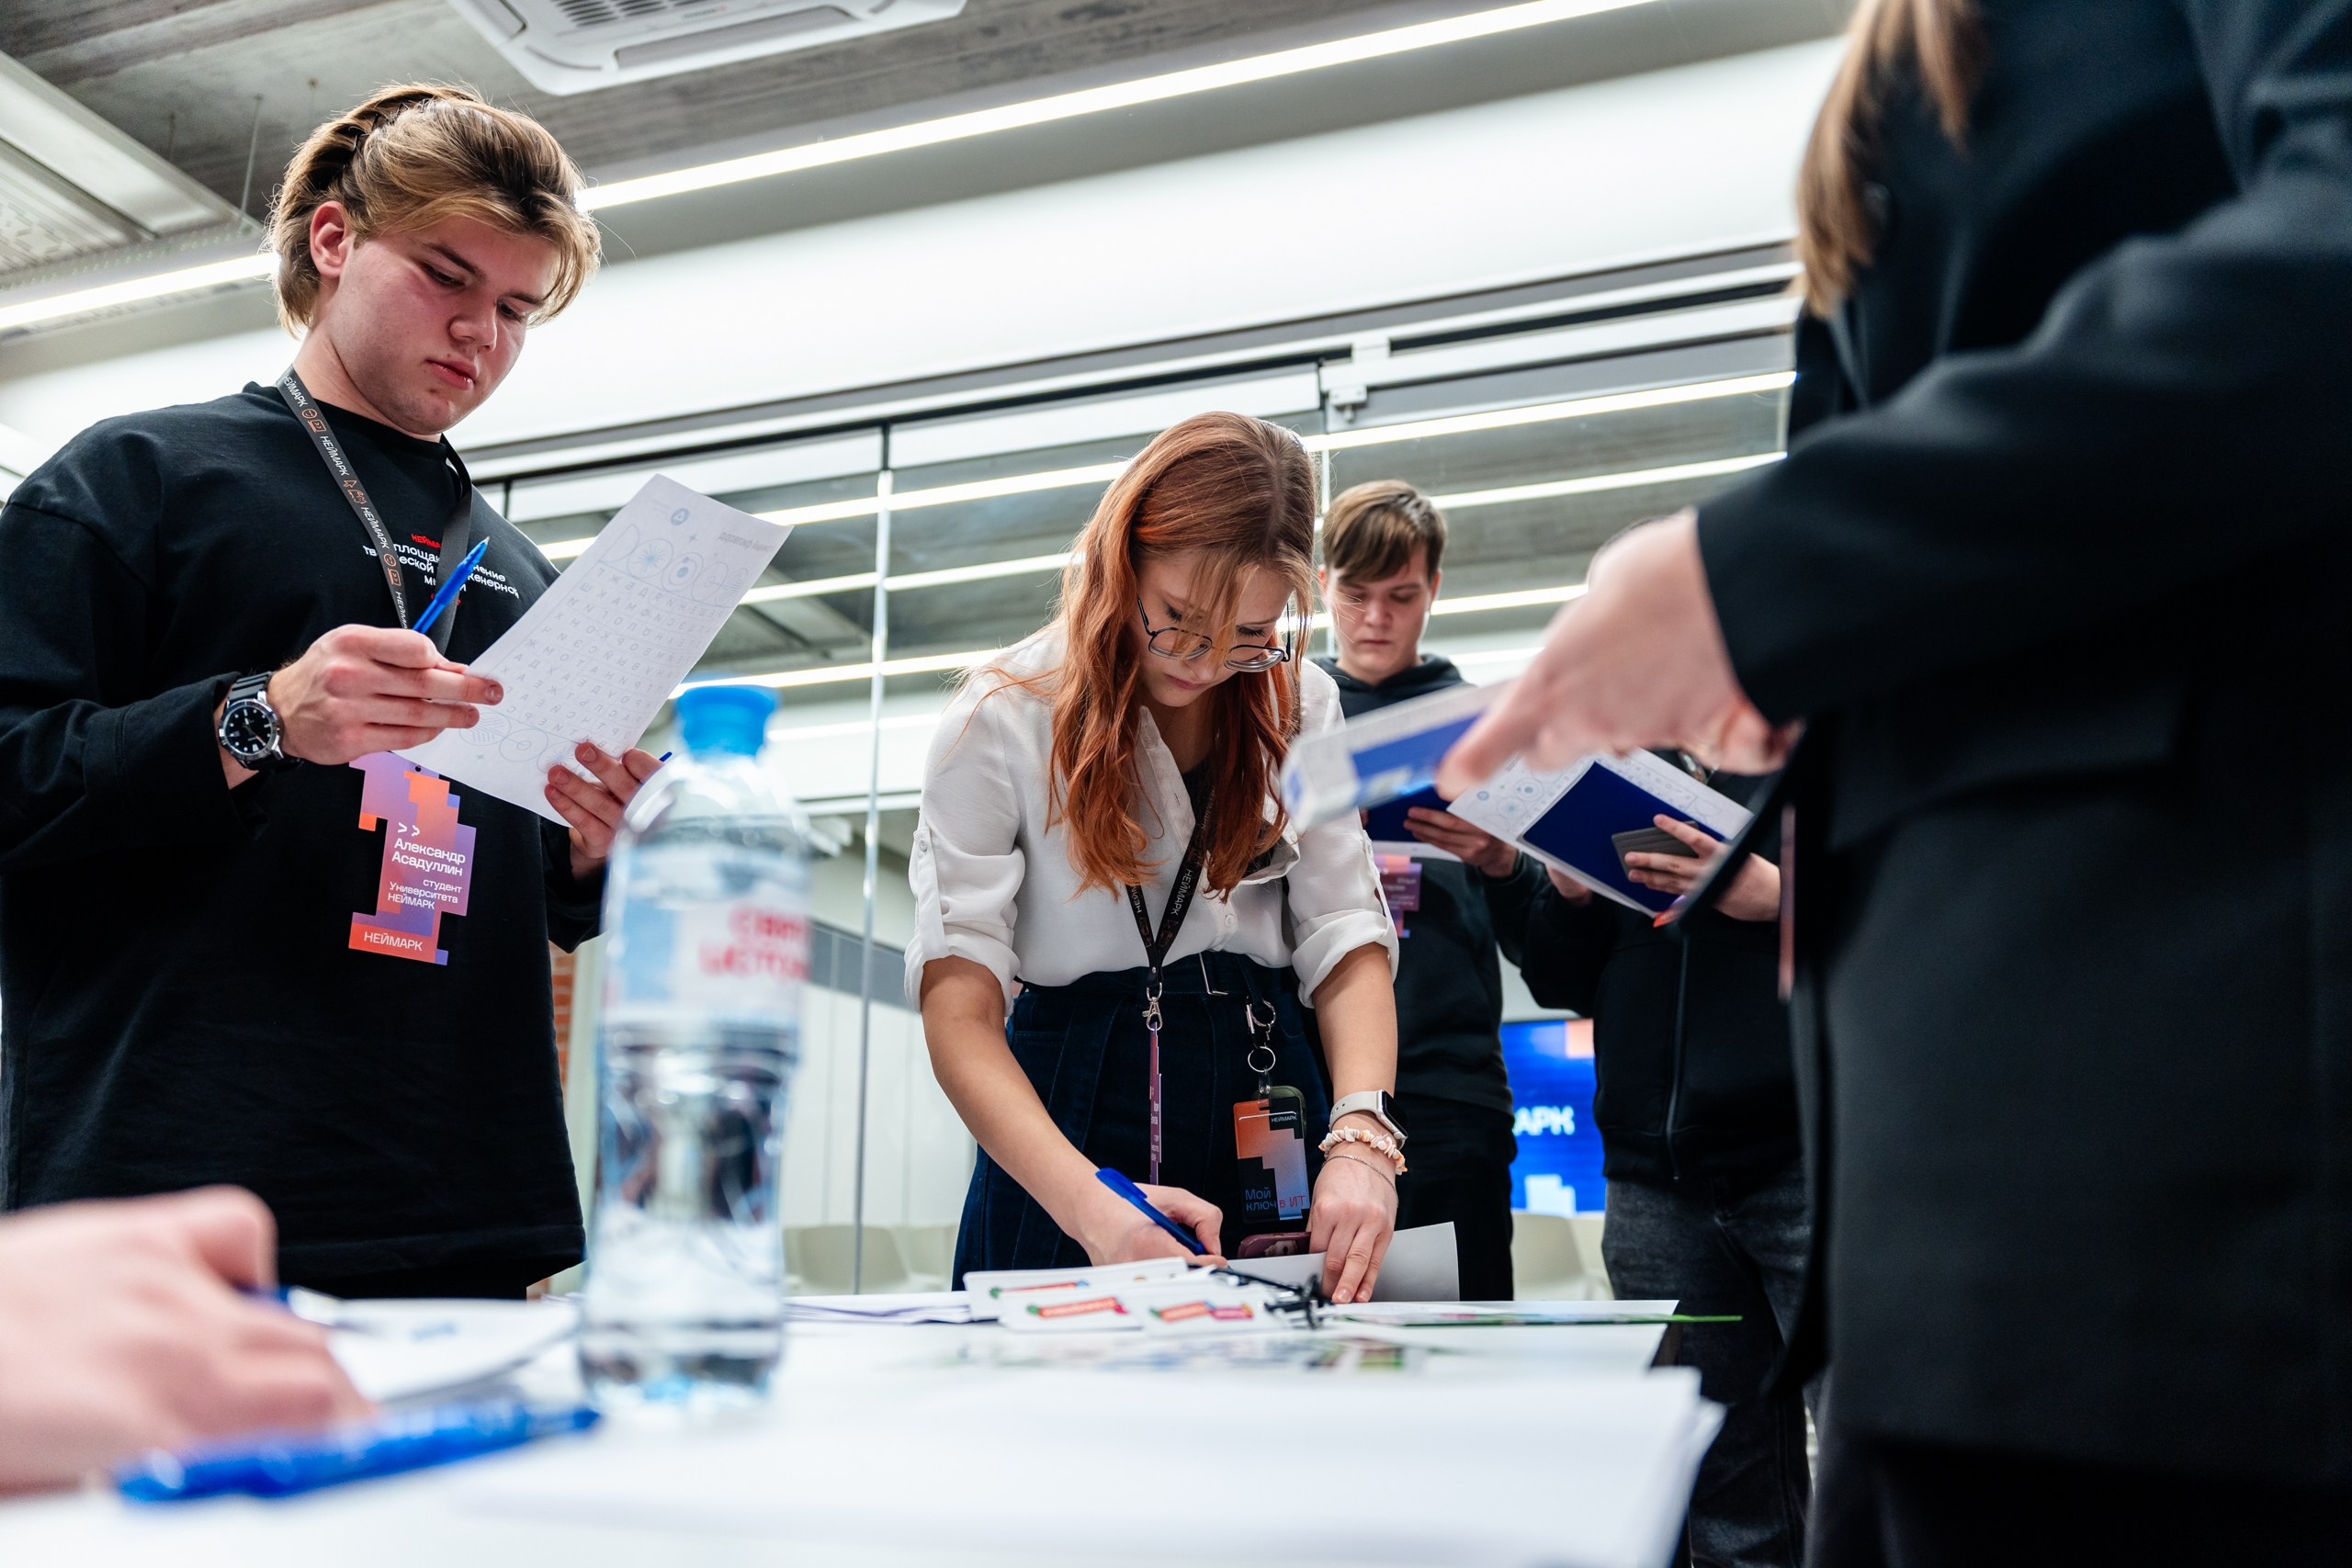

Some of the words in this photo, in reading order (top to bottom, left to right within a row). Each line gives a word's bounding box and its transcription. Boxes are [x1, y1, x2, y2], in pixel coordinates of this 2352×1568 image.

[320, 435, 350, 476] НЕЙМАРК
[361, 506, 390, 549] НЕЙМАРК
[394, 838, 466, 864] Александр
[391, 852, 463, 876] Асадуллин
[389, 881, 458, 904] Университета
[423, 879, 462, 894] студент
[1170, 868, 1193, 916] НЕЙМАРК
[387, 893, 435, 909] НЕЙМАРК
[364, 931, 423, 951] НЕЙМАРК
[1245, 1187, 1272, 1201] Мой
[1246, 1201, 1277, 1212] ключ
[1278, 1200, 1286, 1208] в
[1289, 1195, 1306, 1208] ИТ
